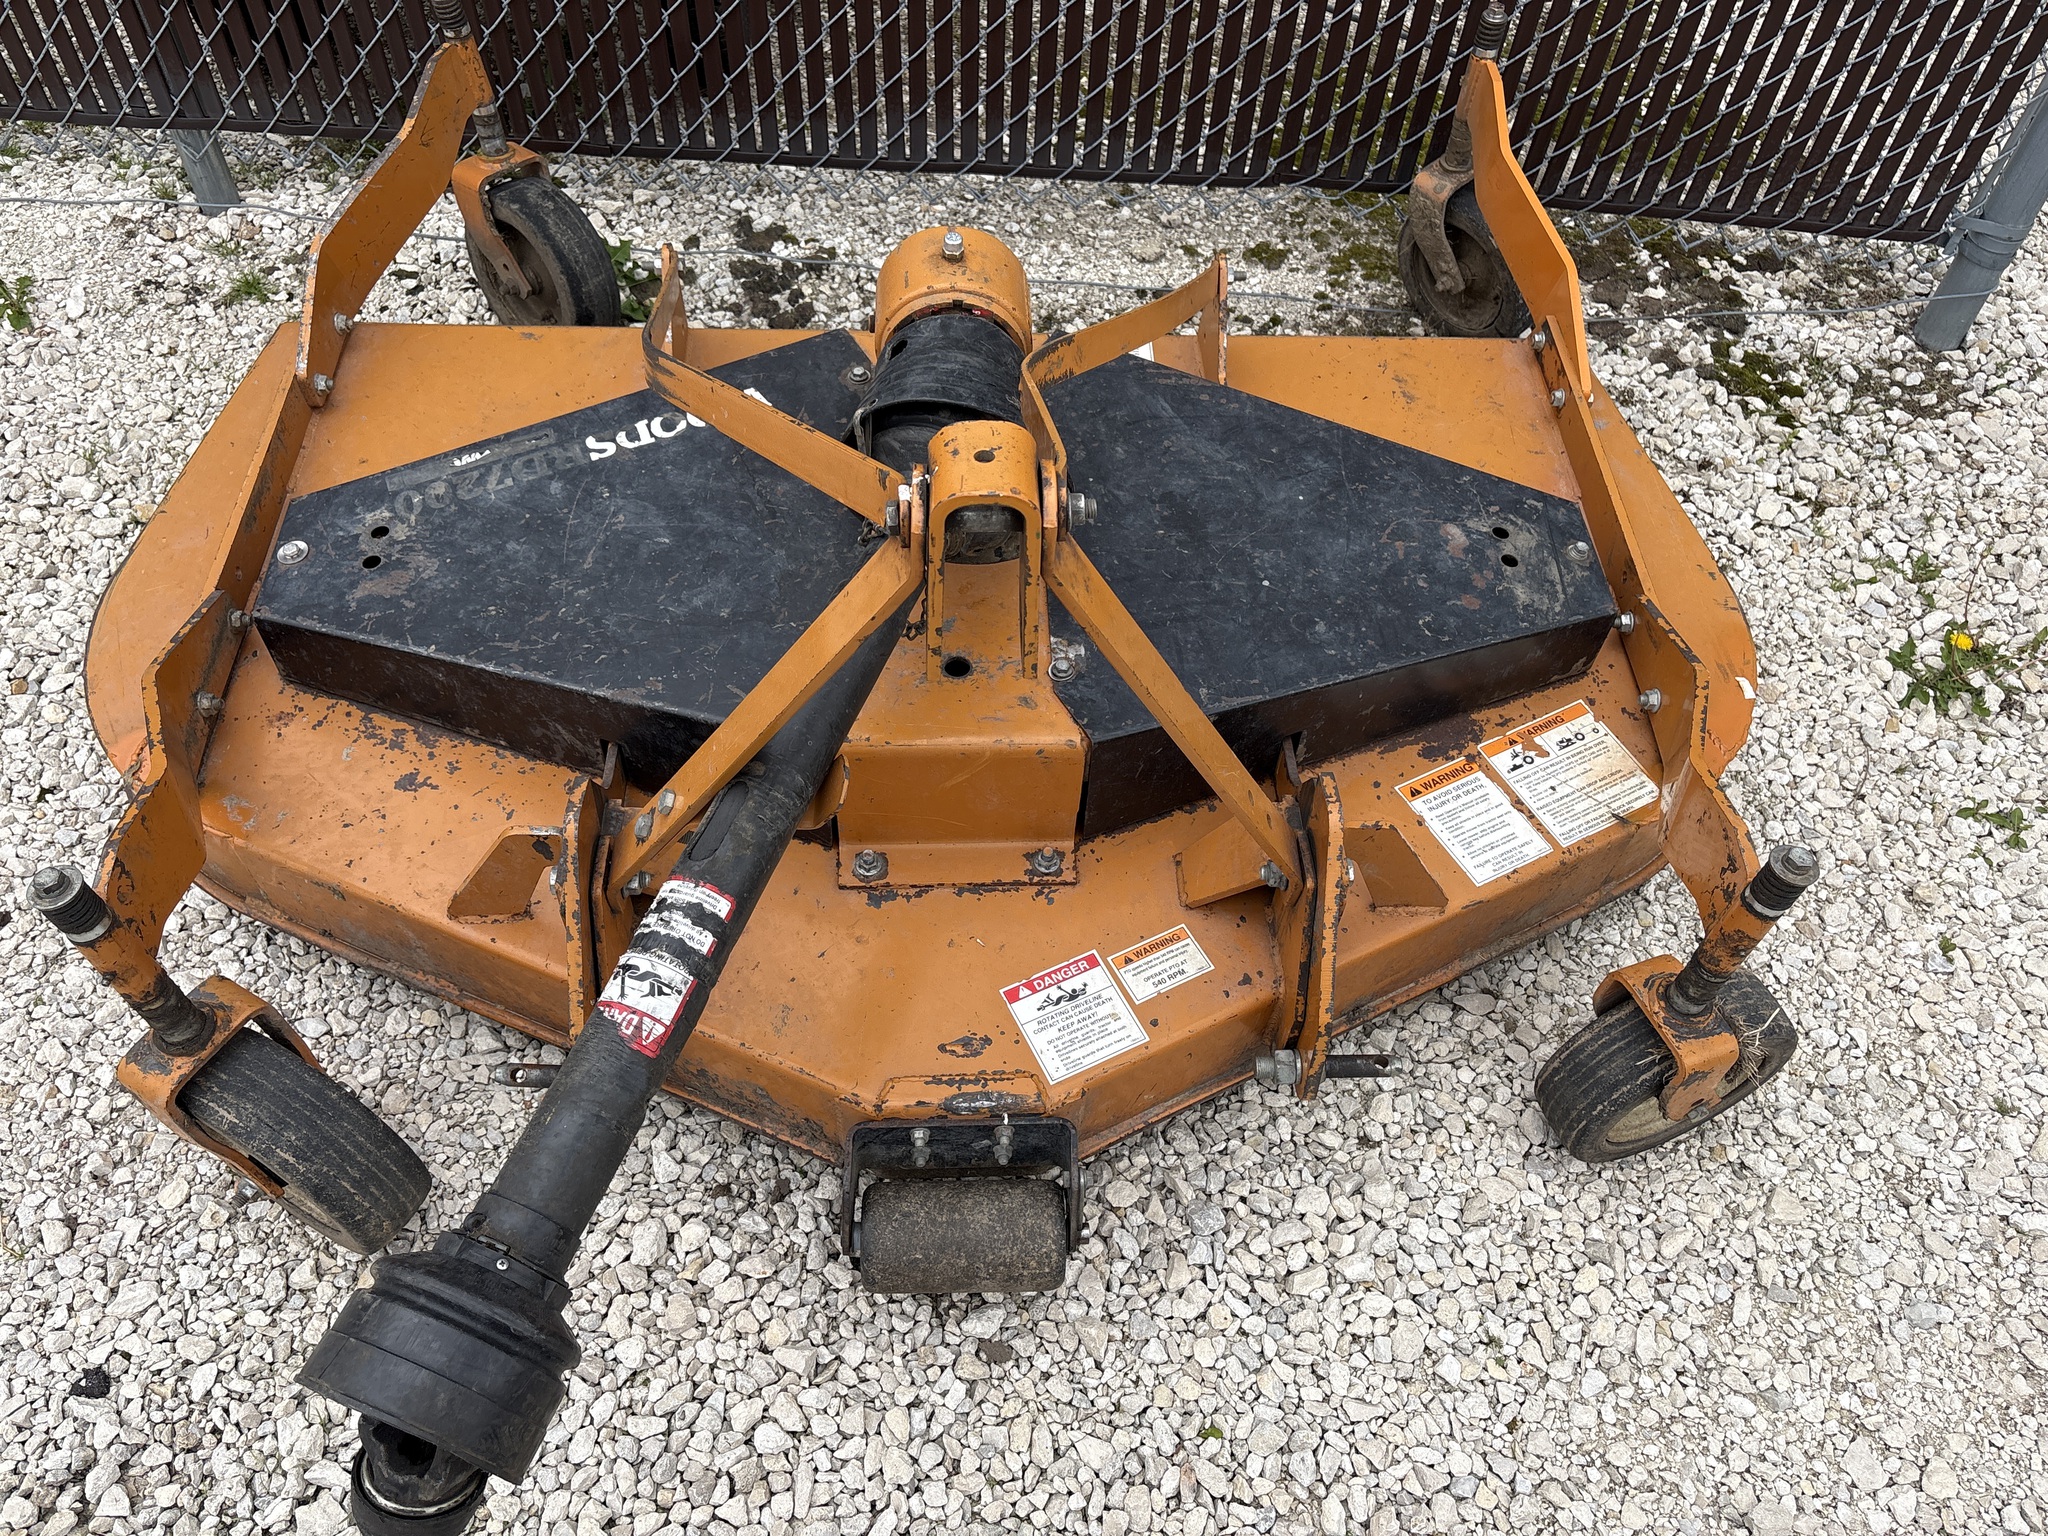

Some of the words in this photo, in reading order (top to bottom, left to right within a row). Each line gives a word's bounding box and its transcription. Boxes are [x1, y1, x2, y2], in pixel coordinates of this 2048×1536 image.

[1517, 715, 1565, 740] ARNING
[1419, 762, 1474, 791] WARNING
[1512, 773, 1532, 785] FALLING
[1530, 769, 1540, 777] OFF
[1549, 757, 1566, 768] RESULT
[1570, 749, 1585, 759] BEING
[1421, 798, 1433, 806] TO
[1432, 789, 1453, 802] AVOID
[1452, 776, 1481, 792] SERIOUS
[1427, 798, 1451, 812] INJURY
[1451, 793, 1463, 802] OR
[1473, 858, 1492, 870] FAILURE
[1497, 846, 1518, 858] OPERATE
[1517, 839, 1534, 849] SAFELY
[1501, 852, 1518, 863] RESULT
[681, 930, 696, 942] NOT
[694, 938, 707, 948] DO
[1132, 933, 1182, 959] WARNING
[648, 950, 692, 975] ROTATING
[1143, 967, 1169, 983] OPERATE
[1168, 962, 1181, 971] PTO
[1180, 958, 1188, 966] AT
[1032, 960, 1090, 991] DANGER
[1151, 977, 1167, 988] 540
[1166, 968, 1189, 981] RPM.
[1033, 1019, 1060, 1035] CONTACT
[1060, 1013, 1074, 1023] CAN
[1073, 1004, 1094, 1017] CAUSE
[1093, 996, 1114, 1009] DEATH
[1036, 1008, 1070, 1027] ROTATING
[1070, 992, 1104, 1012] DRIVELINE
[1057, 1021, 1075, 1033] KEEP
[1076, 1011, 1098, 1025] AWAY!
[1046, 1038, 1056, 1046] DO
[1054, 1033, 1066, 1042] NOT
[1066, 1023, 1090, 1037] OPERATE
